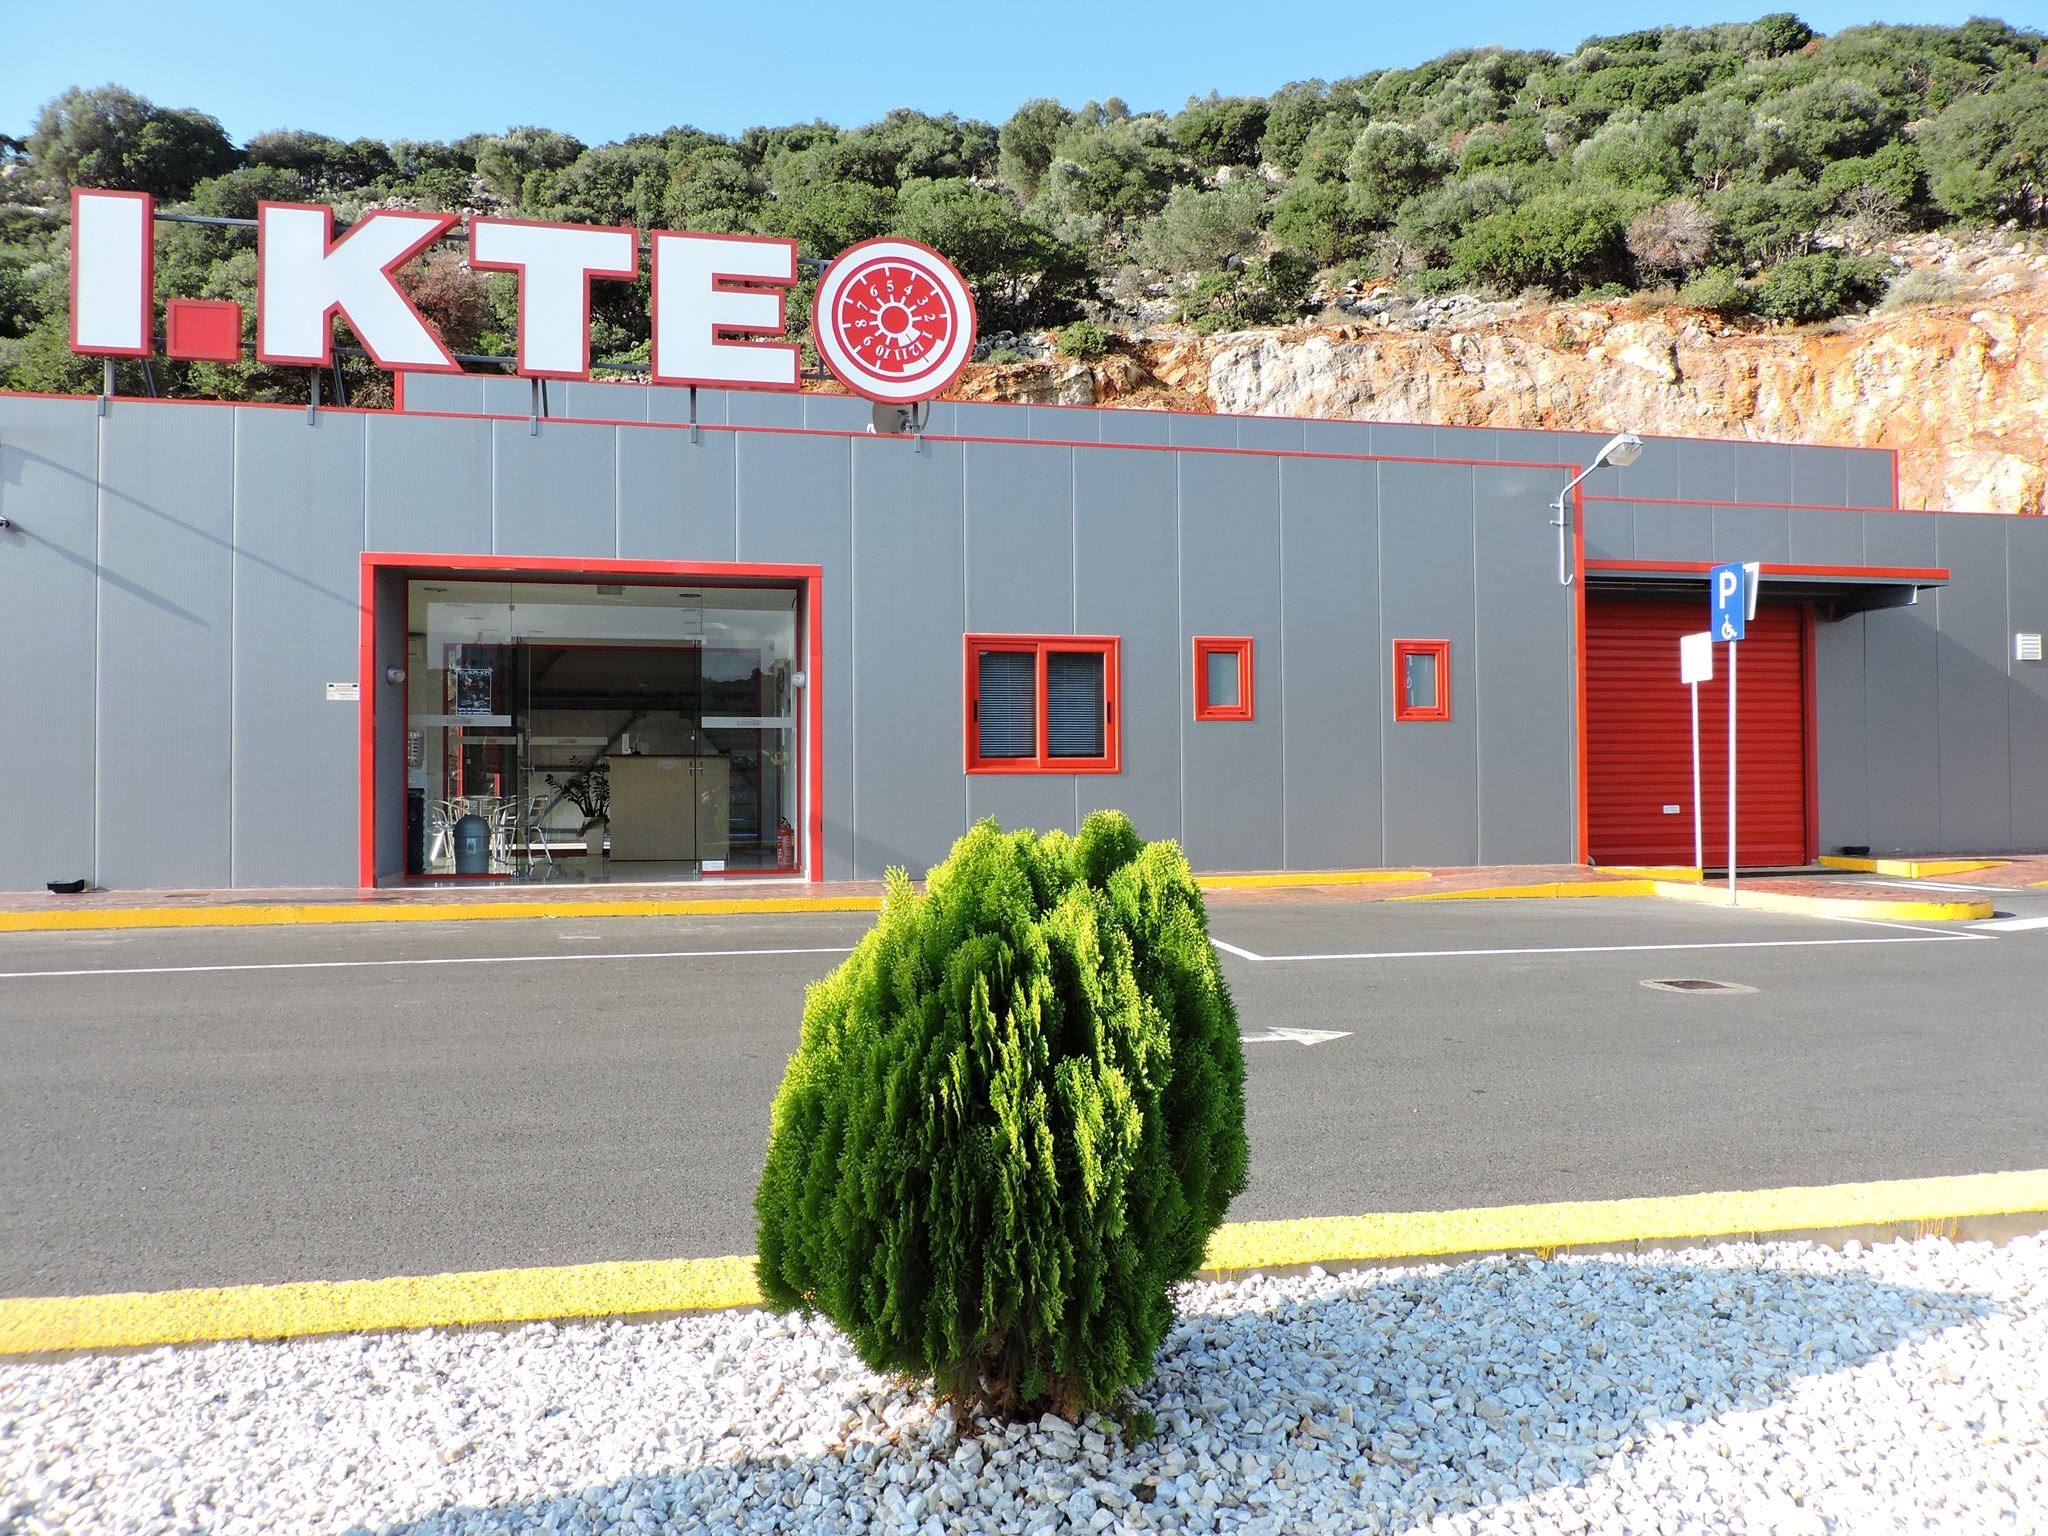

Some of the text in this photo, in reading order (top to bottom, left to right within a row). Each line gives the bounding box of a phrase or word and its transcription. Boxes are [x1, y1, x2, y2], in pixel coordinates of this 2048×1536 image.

[870, 284, 878, 297] 6
[886, 280, 894, 292] 5
[904, 284, 913, 295] 4
[857, 301, 868, 310] 7
[917, 296, 928, 305] 3
[855, 319, 867, 328] 8
[922, 330, 933, 339] 1
[862, 337, 873, 346] 9
[875, 345, 891, 359] 10
[909, 341, 924, 356] 12
[895, 348, 909, 361] 11
[1719, 572, 1737, 609] P
